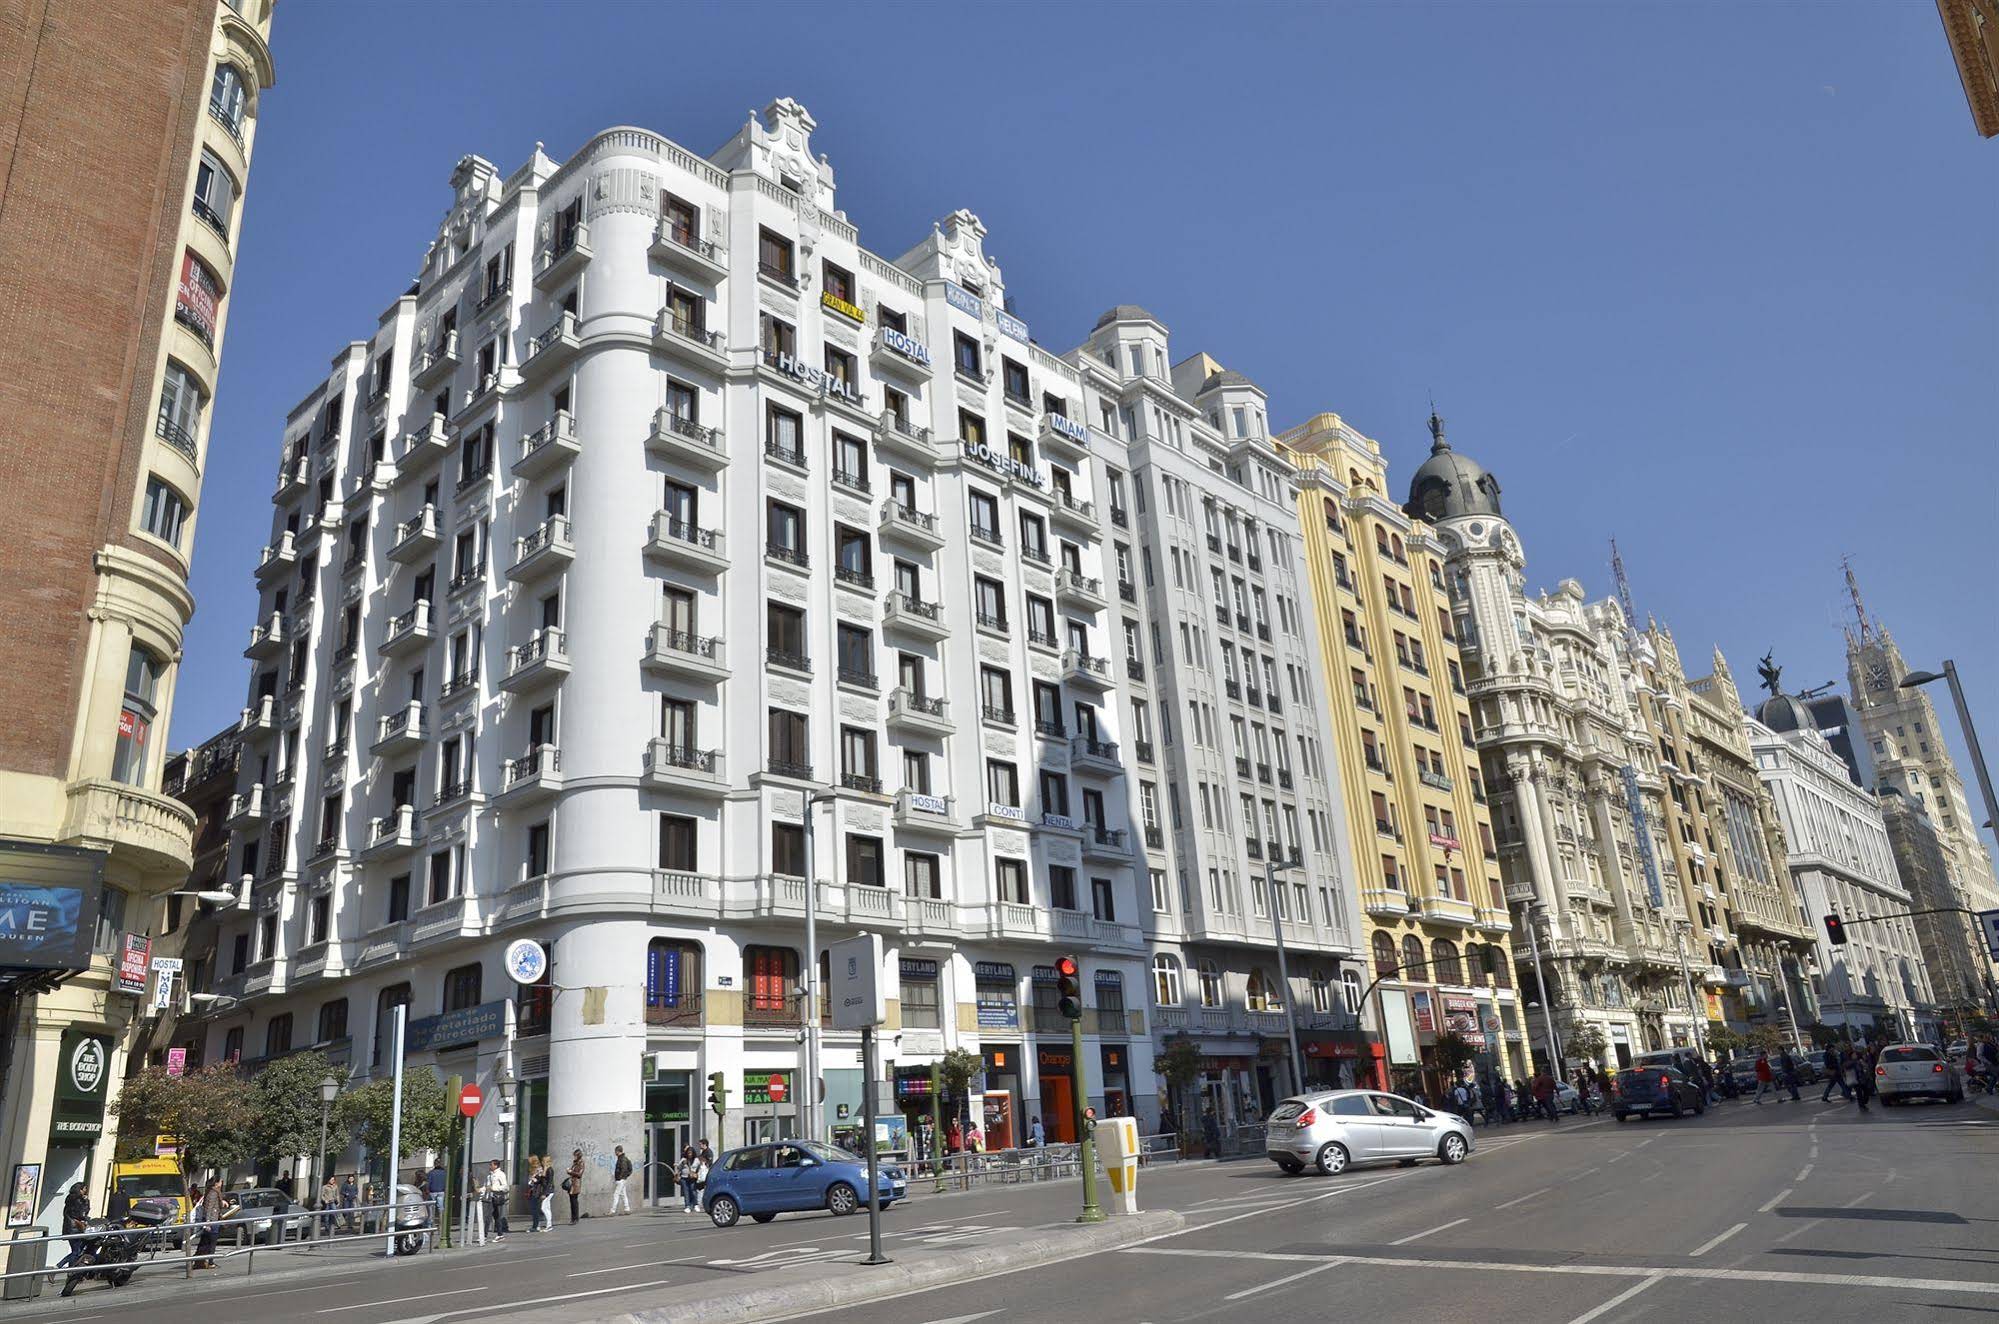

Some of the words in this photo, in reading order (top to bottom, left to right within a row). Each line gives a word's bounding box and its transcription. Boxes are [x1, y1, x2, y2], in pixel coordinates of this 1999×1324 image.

[179, 282, 190, 297] EN
[887, 328, 931, 363] HOSTAL
[779, 351, 857, 400] HOSTAL
[1054, 415, 1089, 443] MIAMI
[969, 441, 1046, 484] JOSEFINA
[119, 722, 132, 733] SOE
[911, 796, 946, 812] HOSTAL
[994, 805, 1024, 819] CONTI
[153, 959, 180, 970] HOSTAL
[82, 1053, 96, 1062] THE
[77, 1062, 98, 1073] BODY
[77, 1072, 96, 1081] SHOP
[56, 1121, 69, 1131] THE
[69, 1121, 86, 1131] BODY
[86, 1121, 103, 1132] SHOP
